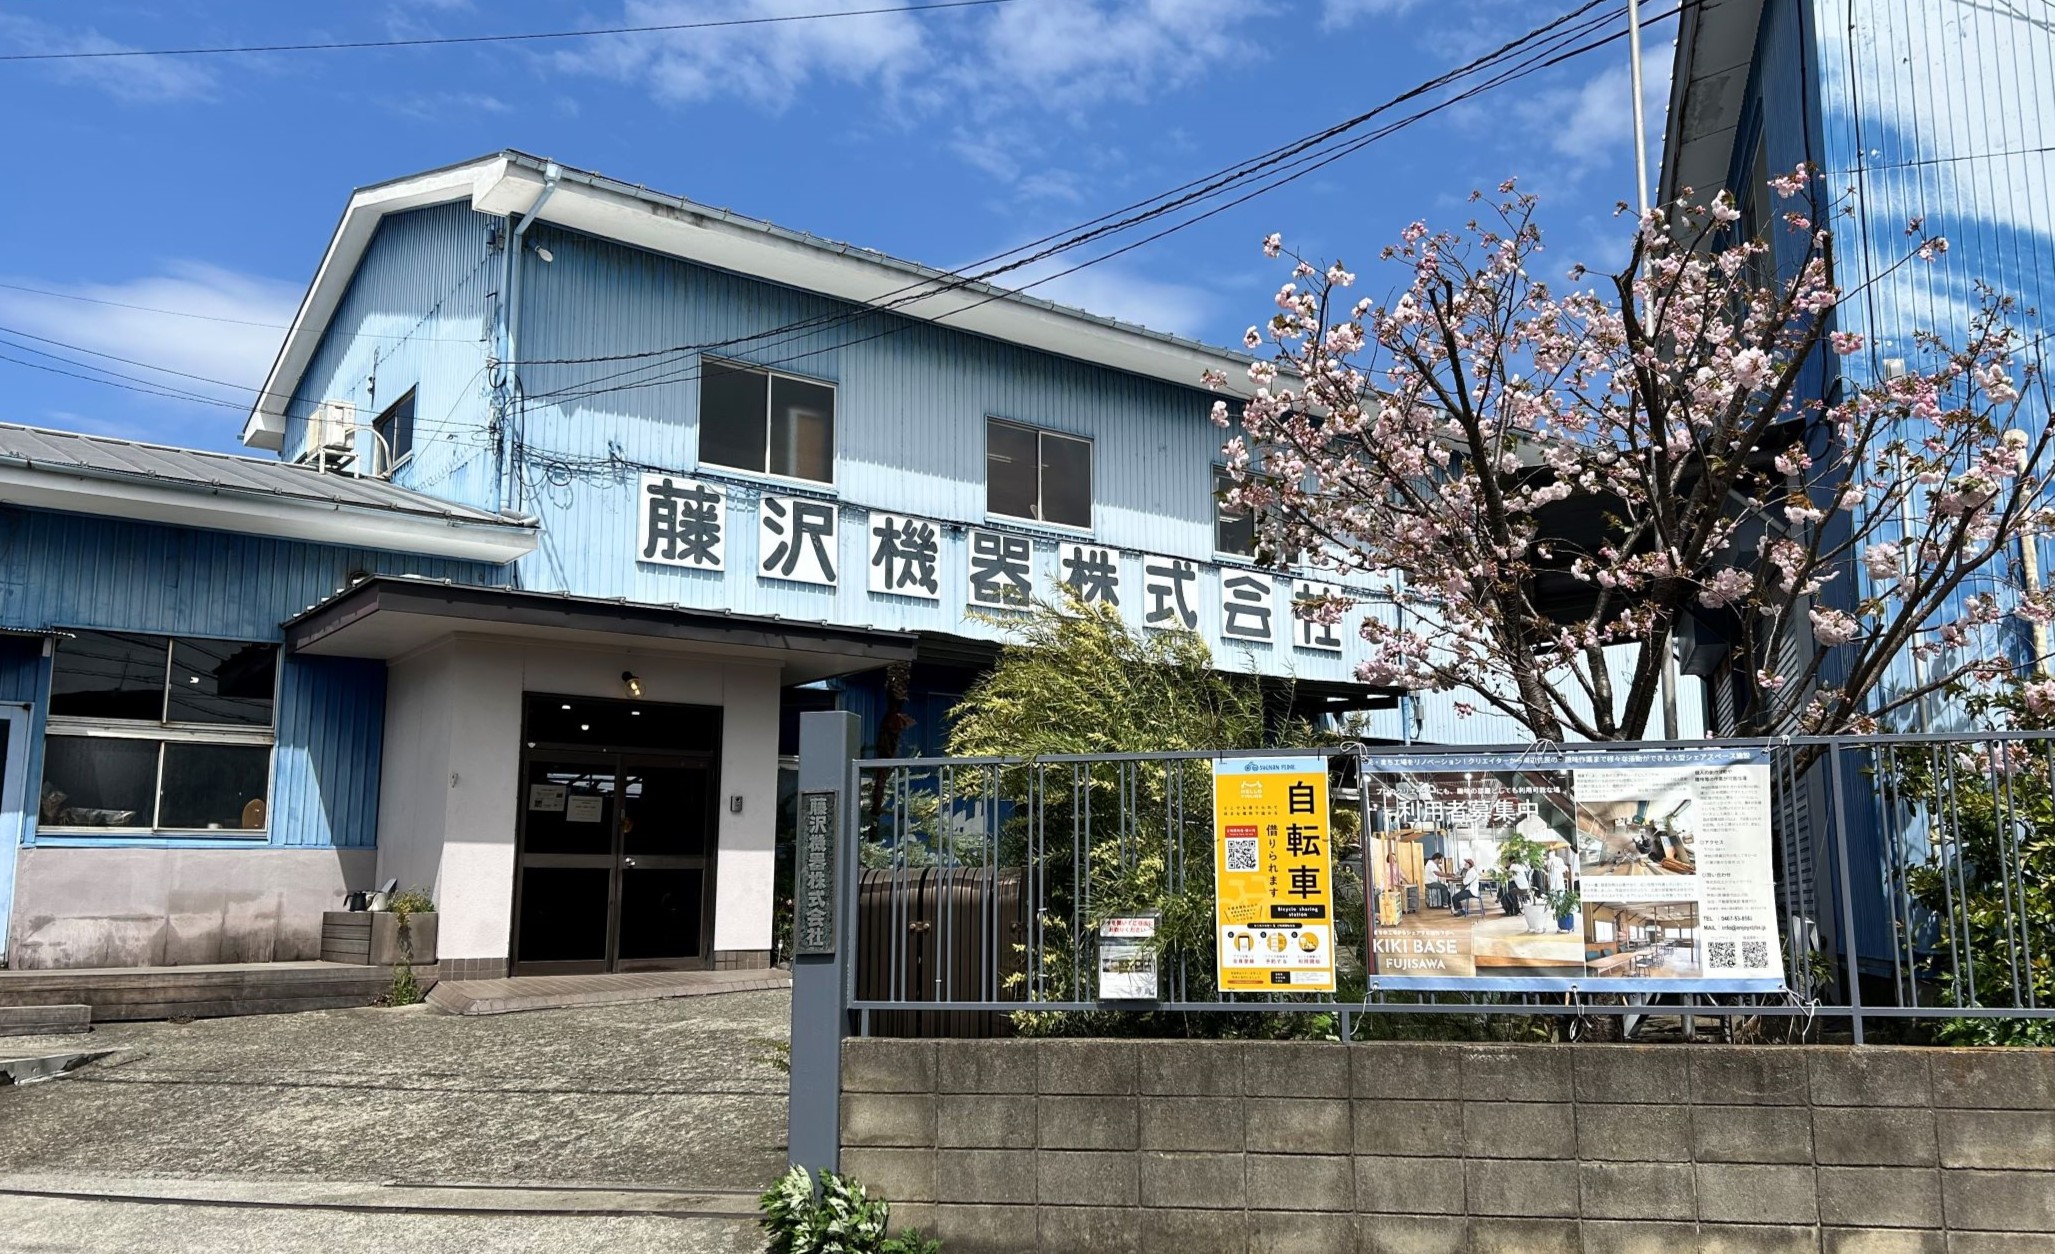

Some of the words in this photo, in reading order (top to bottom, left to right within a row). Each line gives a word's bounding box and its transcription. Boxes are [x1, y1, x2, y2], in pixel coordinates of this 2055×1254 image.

[646, 478, 1341, 647] 藤沢機器株式会社
[1399, 798, 1540, 823] 利用者募集中
[1265, 823, 1279, 898] 借りられます
[1286, 780, 1322, 900] 自転車
[806, 797, 828, 947] 藤沢機器株式会社
[1277, 906, 1297, 914] Bicycle
[1299, 906, 1319, 914] sharing
[1373, 938, 1408, 954] KIKI
[1413, 938, 1458, 954] BASE
[1386, 958, 1446, 970] FUJISAWA
